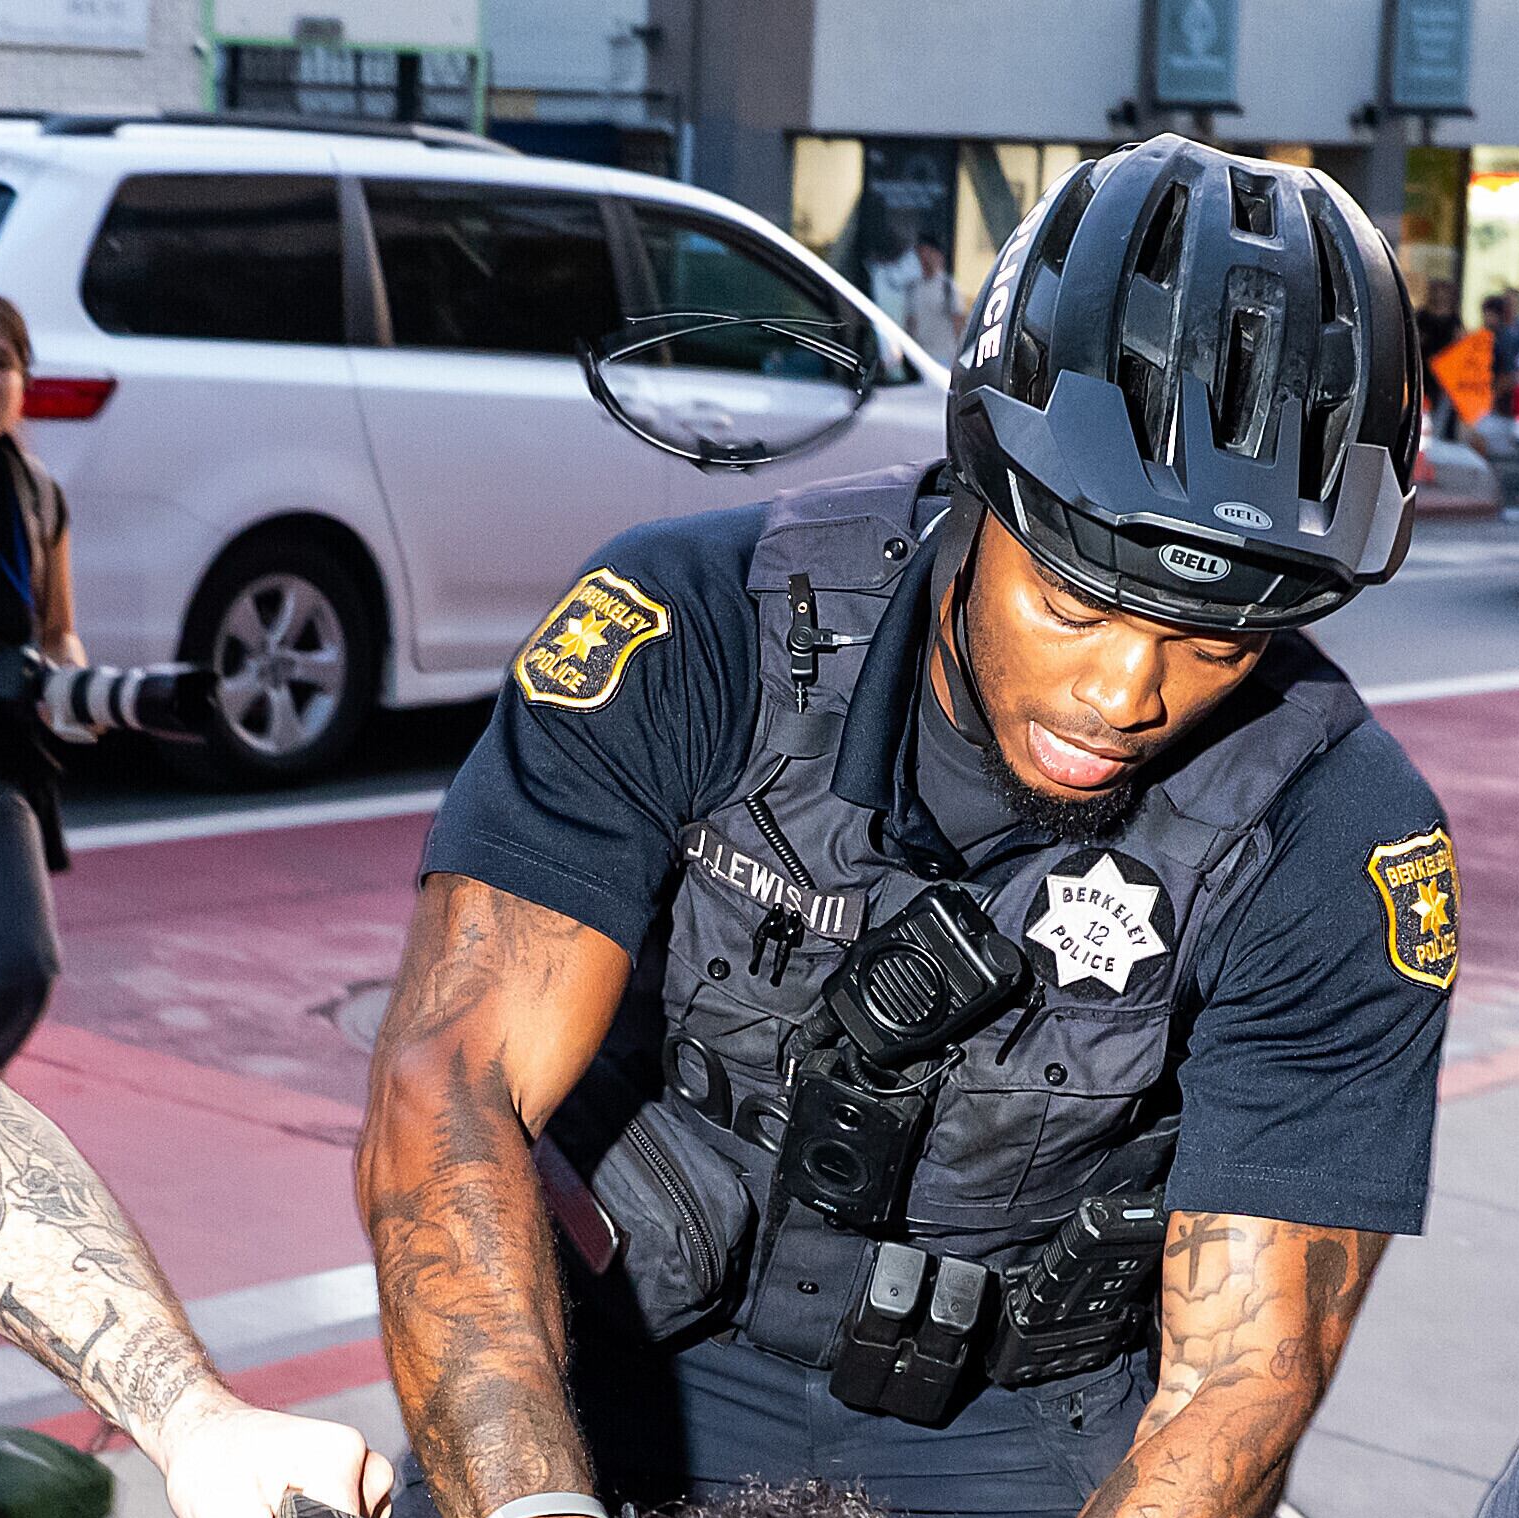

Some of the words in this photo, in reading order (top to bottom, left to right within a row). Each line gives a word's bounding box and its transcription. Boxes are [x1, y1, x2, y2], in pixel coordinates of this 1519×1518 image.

[1170, 548, 1218, 575] BELL
[578, 584, 652, 635] BERKELEY
[529, 647, 588, 694] POLICE
[809, 895, 846, 933] III
[1062, 886, 1148, 946] BERKELEY
[1083, 920, 1110, 948] 12
[1049, 924, 1116, 973] POLICE
